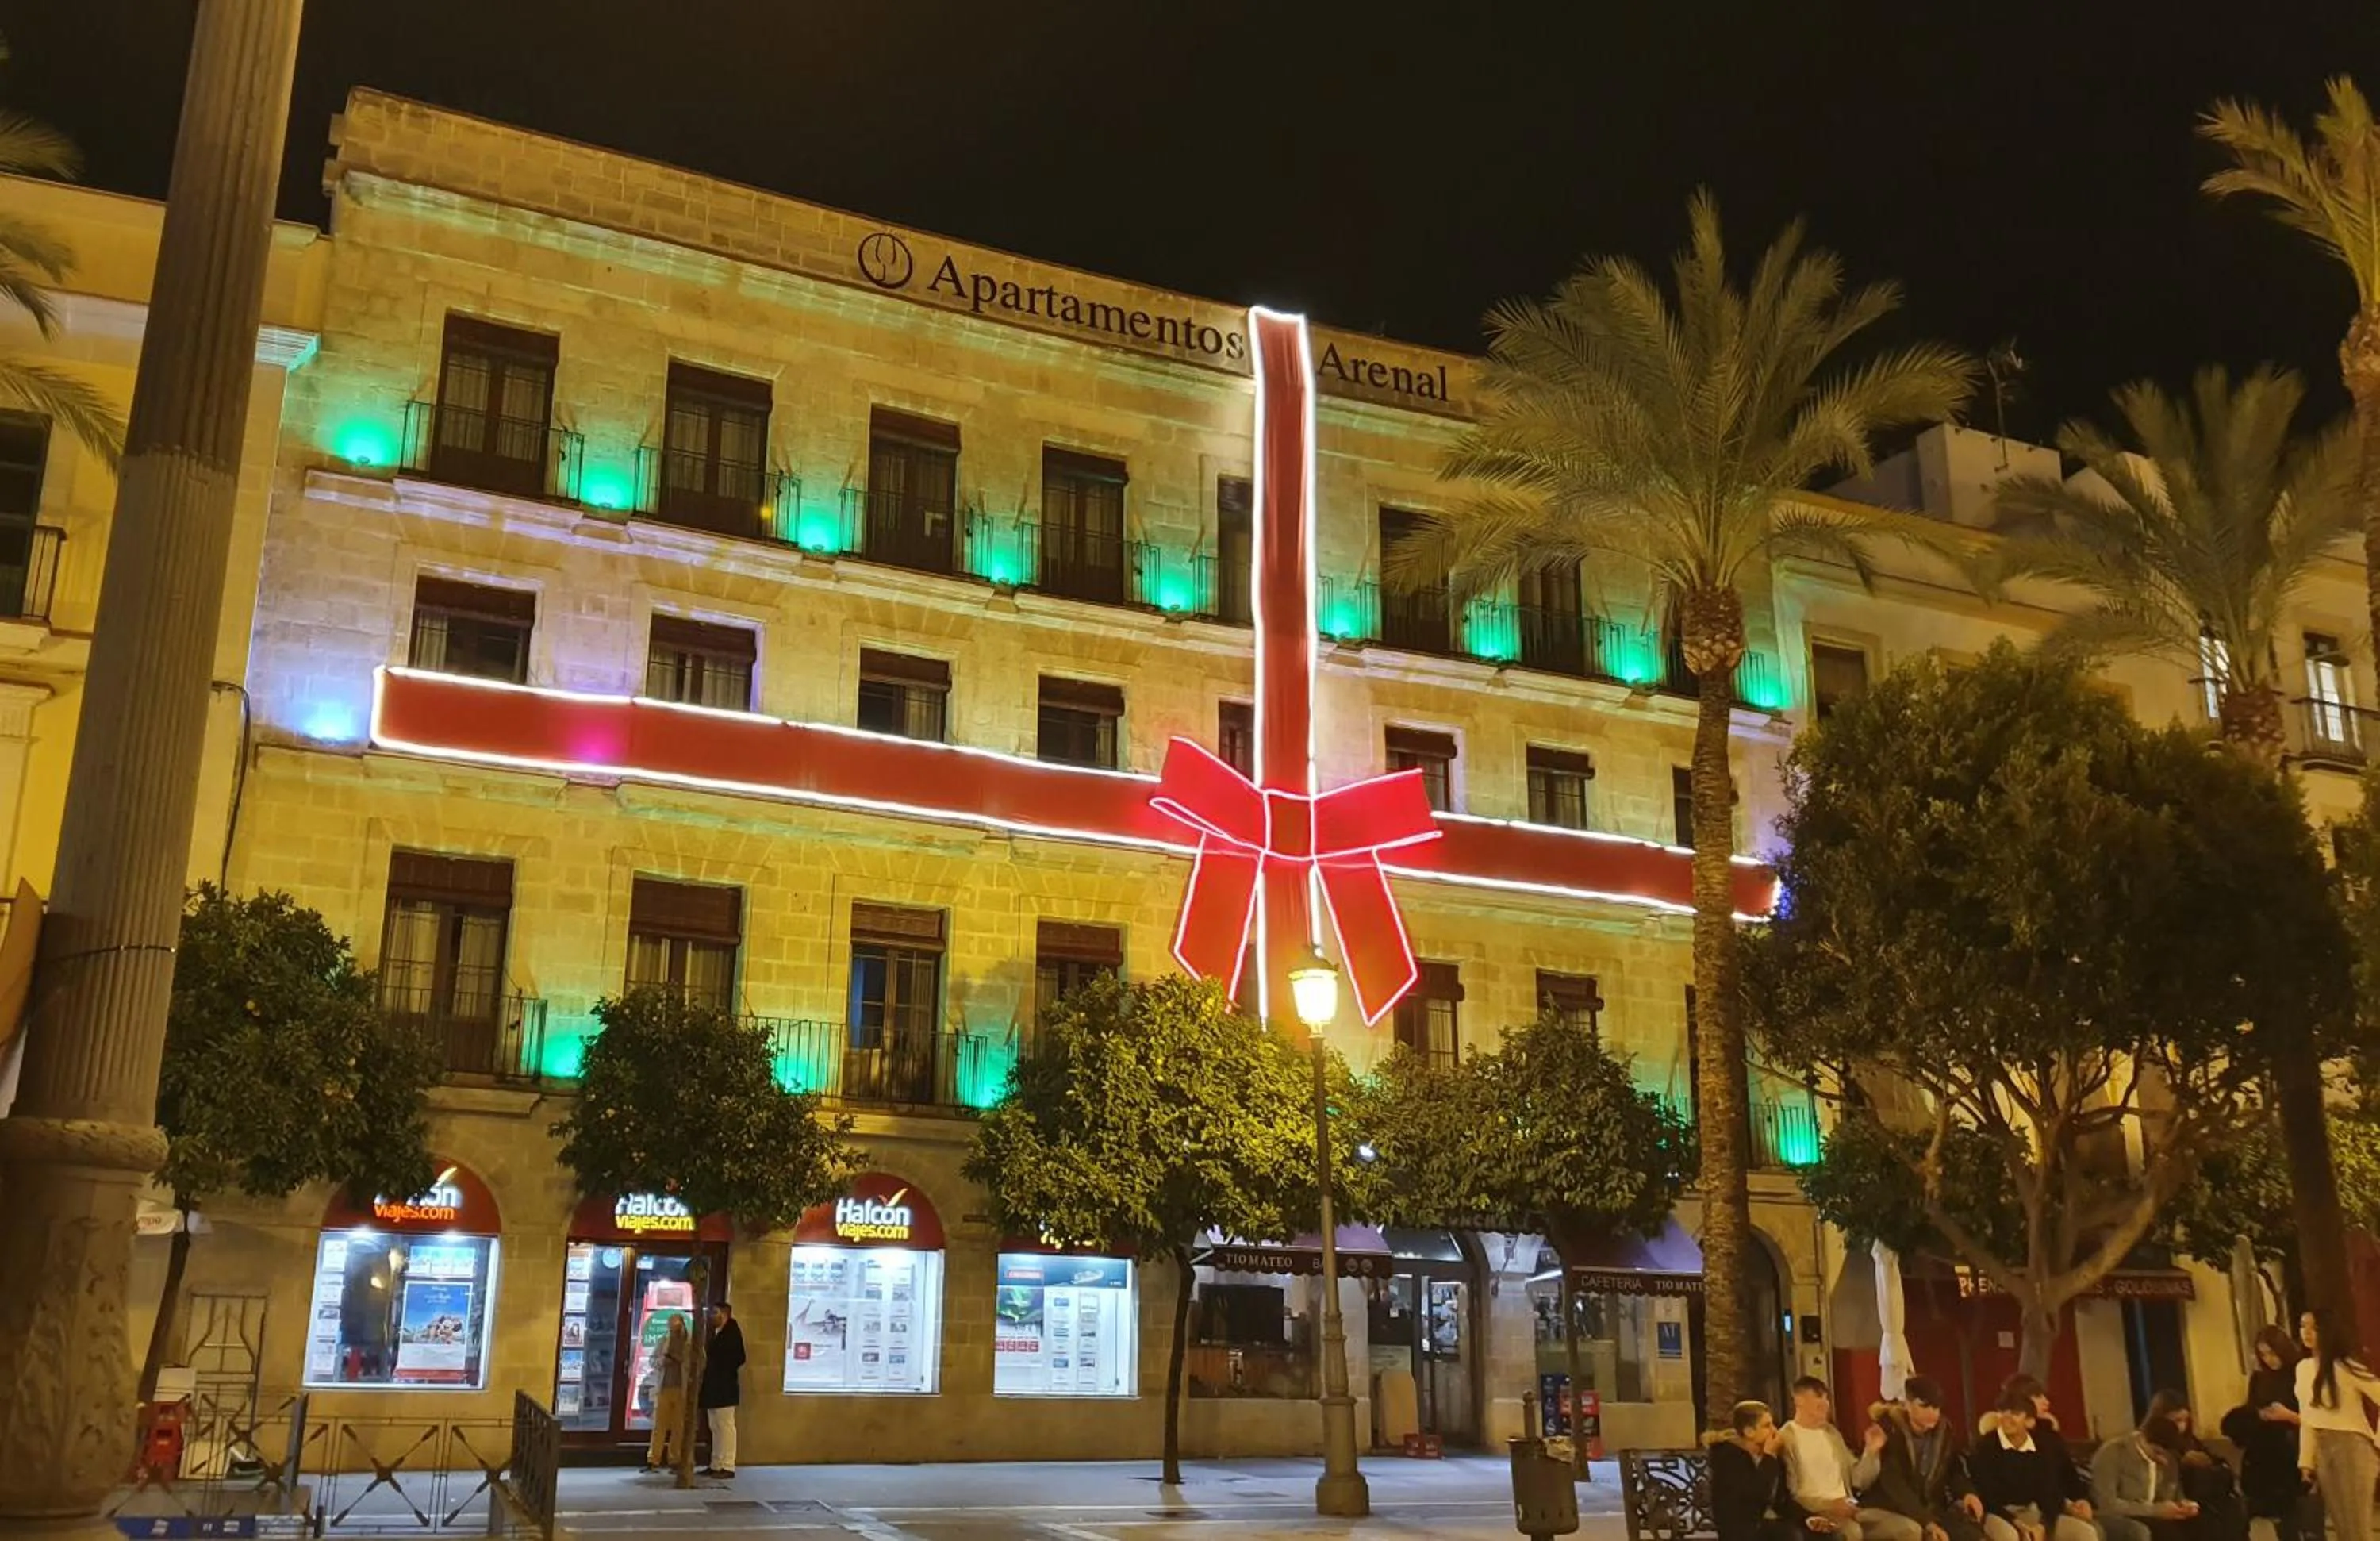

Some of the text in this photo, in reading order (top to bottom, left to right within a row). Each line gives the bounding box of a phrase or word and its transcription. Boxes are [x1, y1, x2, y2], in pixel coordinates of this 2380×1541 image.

[927, 255, 1447, 402] Apartamentos Arenal
[374, 1204, 455, 1223] viajes.com
[615, 1215, 694, 1234] viajes.com
[835, 1223, 909, 1243] viajes.com
[1581, 1275, 1644, 1289] CAFETERIA
[1675, 1281, 1703, 1292] MATE
